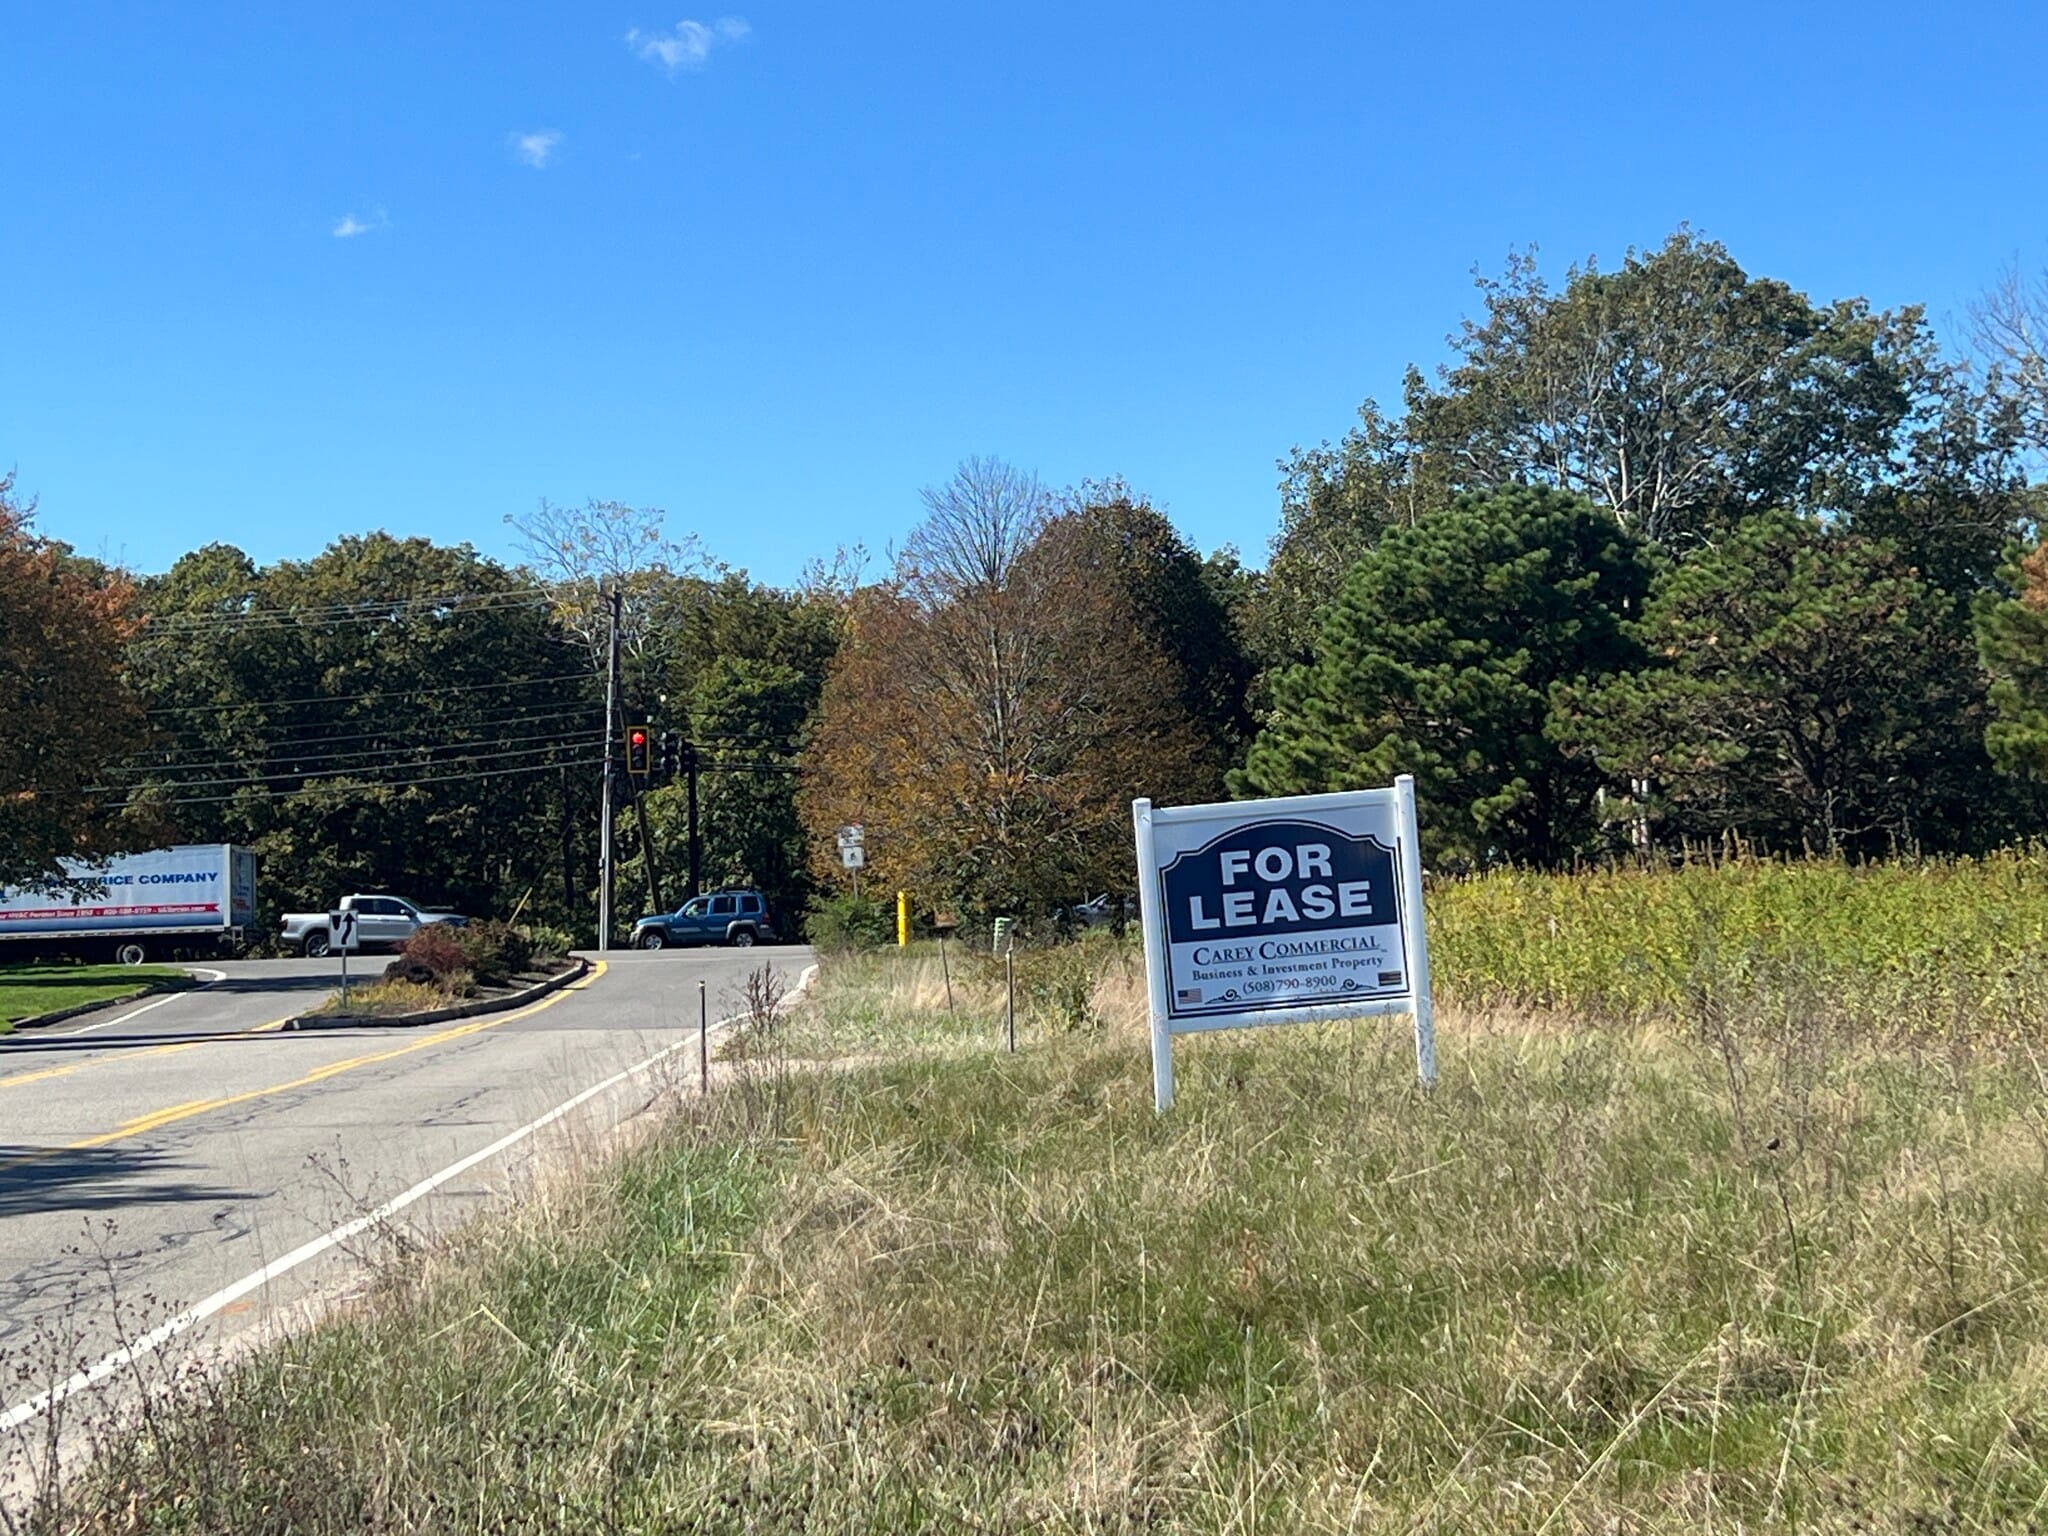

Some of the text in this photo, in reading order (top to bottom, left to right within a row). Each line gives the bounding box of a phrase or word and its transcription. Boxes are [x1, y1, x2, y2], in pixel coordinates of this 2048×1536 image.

[1220, 843, 1333, 885] FOR
[138, 872, 218, 886] COMPANY
[1189, 880, 1373, 930] LEASE
[1193, 936, 1380, 965] CAREY COMMERCIAL
[1192, 956, 1384, 981] Business & Investment Property
